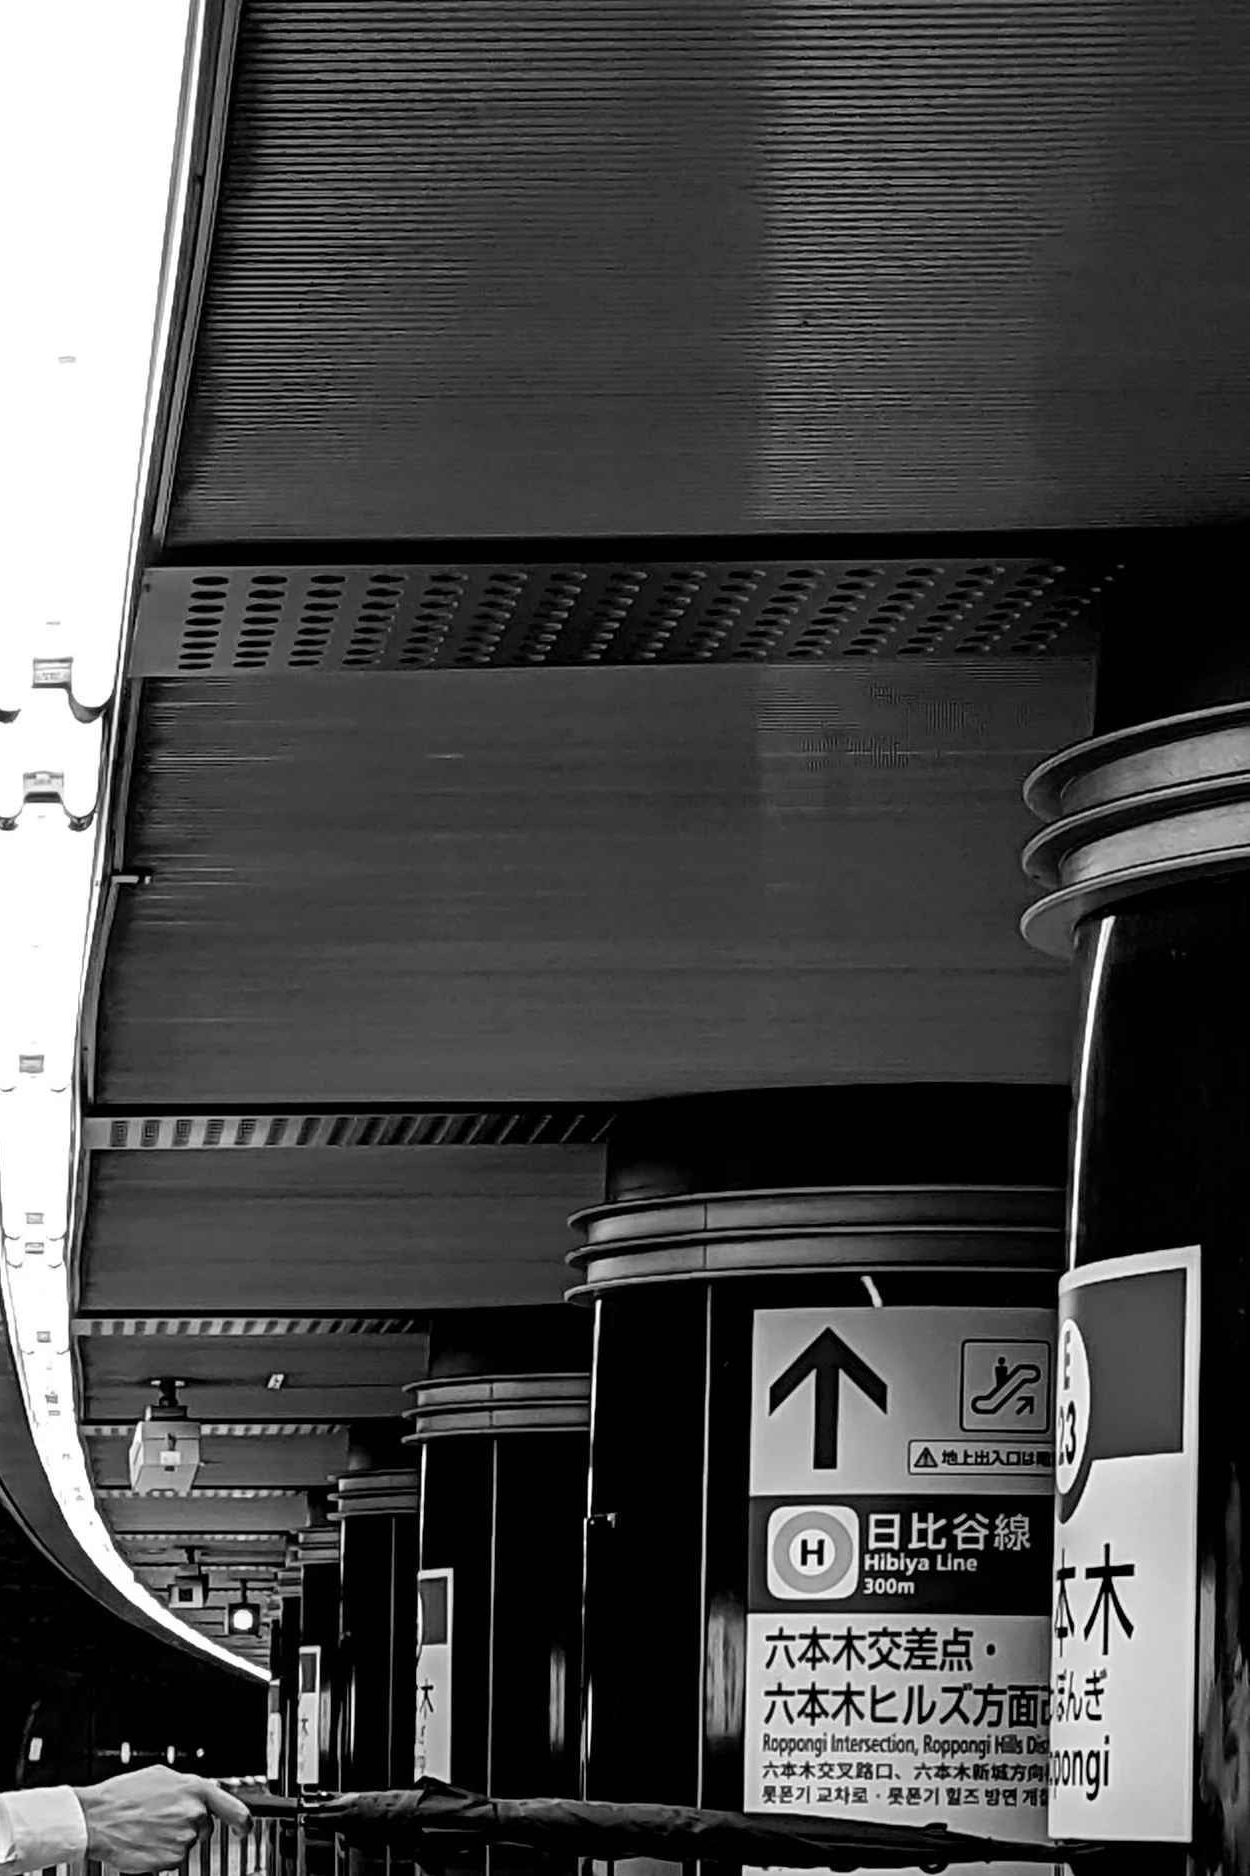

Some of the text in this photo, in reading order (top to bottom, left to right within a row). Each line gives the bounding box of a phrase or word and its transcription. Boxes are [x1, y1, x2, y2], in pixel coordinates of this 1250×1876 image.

[867, 1512, 1032, 1551] 日比谷線
[800, 1538, 825, 1567] H
[863, 1553, 978, 1576] Hibiya Line
[863, 1577, 915, 1595] 300m
[762, 1732, 828, 1760] Roppongi
[923, 1733, 992, 1760] Roppongi
[913, 1761, 1050, 1783] 六本木新城方向
[1050, 1734, 1110, 1802] pongi
